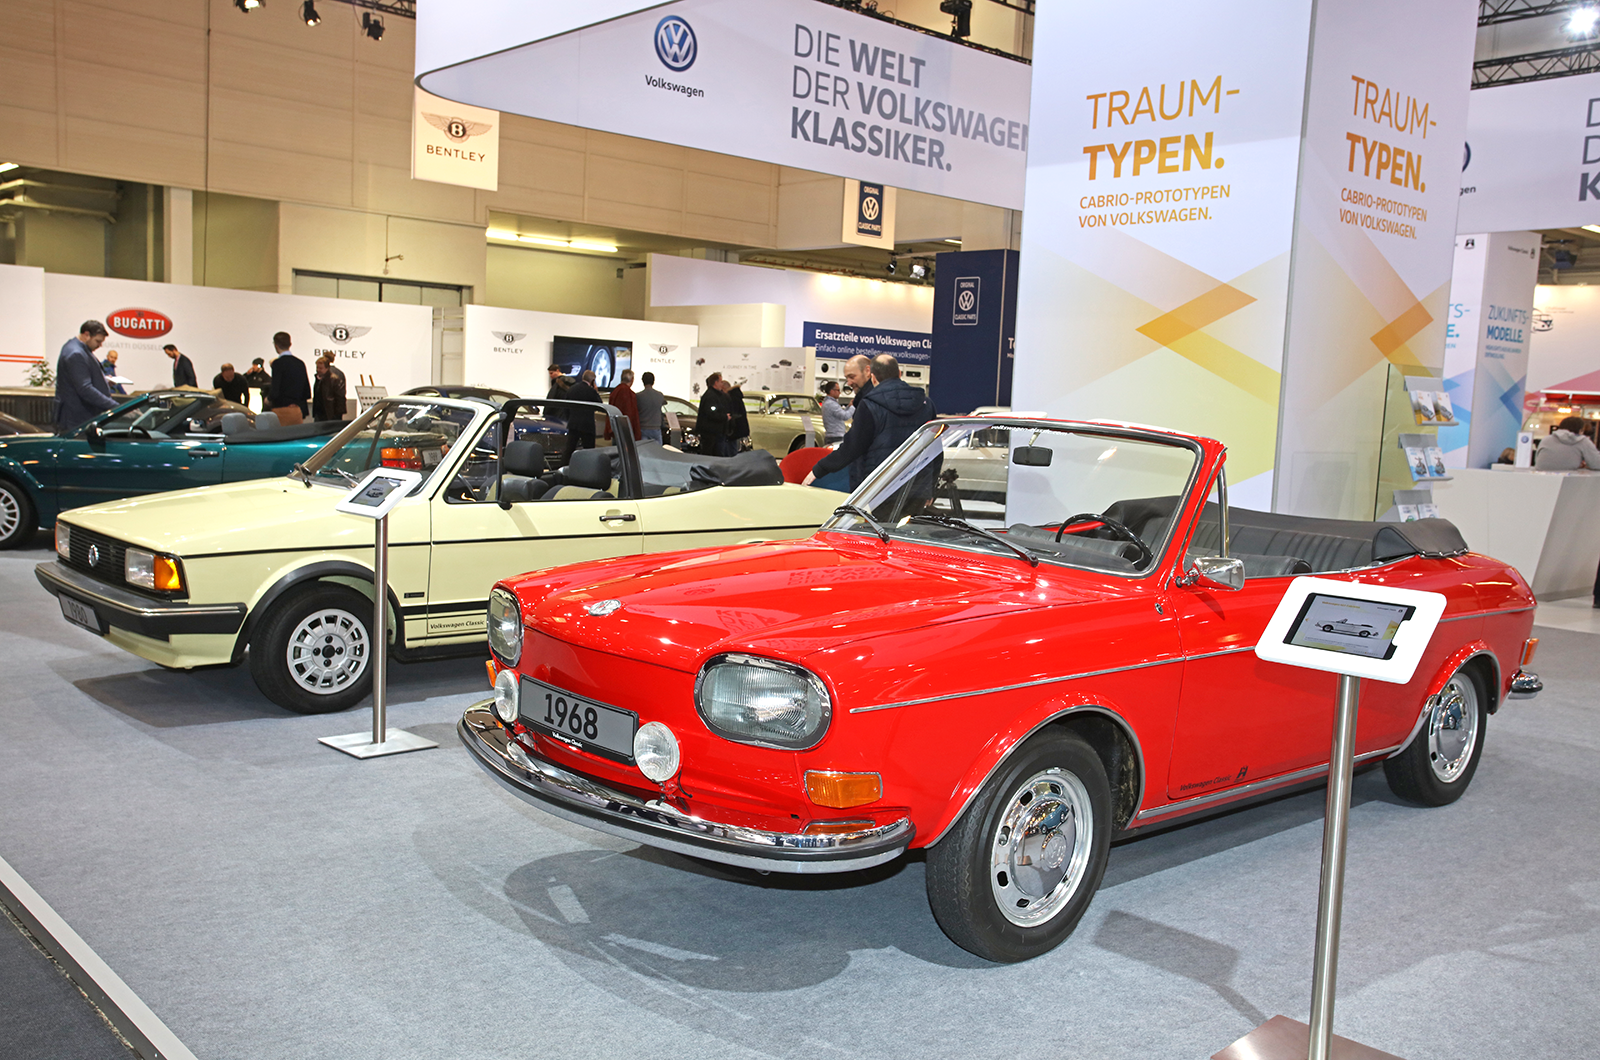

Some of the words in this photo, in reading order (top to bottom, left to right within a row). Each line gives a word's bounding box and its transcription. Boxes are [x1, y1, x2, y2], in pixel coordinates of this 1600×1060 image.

[794, 23, 841, 67] DIE
[849, 38, 926, 88] WELT
[645, 74, 704, 98] Volkswagen
[792, 64, 850, 110] DER
[1086, 75, 1240, 129] TRAUM-
[1351, 74, 1437, 139] TRAUM-
[791, 106, 952, 172] KLASSIKER.
[426, 144, 486, 162] BENTLEY
[1083, 131, 1225, 181] TYPEN.
[1346, 131, 1426, 193] TYPEN.
[1079, 184, 1231, 209] CABRIO-PROTOTYPEN
[1341, 187, 1427, 222] CABRIO-PROTOTYPEN
[1078, 213, 1107, 228] VON
[1110, 206, 1212, 226] VOLKSWAGEN.
[1339, 208, 1359, 226] VON
[1360, 213, 1417, 240] VOLKSWAGEN.
[113, 316, 166, 331] BUGATTI
[1488, 304, 1530, 324] ZUKUNFTS-
[132, 342, 164, 350] DÜSSELD
[815, 329, 859, 342] Ersatzteile
[860, 335, 875, 344] von
[876, 335, 921, 349] Volkswagen
[1486, 325, 1524, 343] MODELLE.
[493, 346, 524, 354] BENTLEY
[814, 343, 836, 352] Einfach
[837, 346, 855, 354] online
[67, 600, 89, 625] 1980
[430, 622, 465, 630] Volkswagen
[543, 693, 598, 740] 1968
[1180, 779, 1213, 791] Volkswagen
[1213, 775, 1232, 784] Classic
